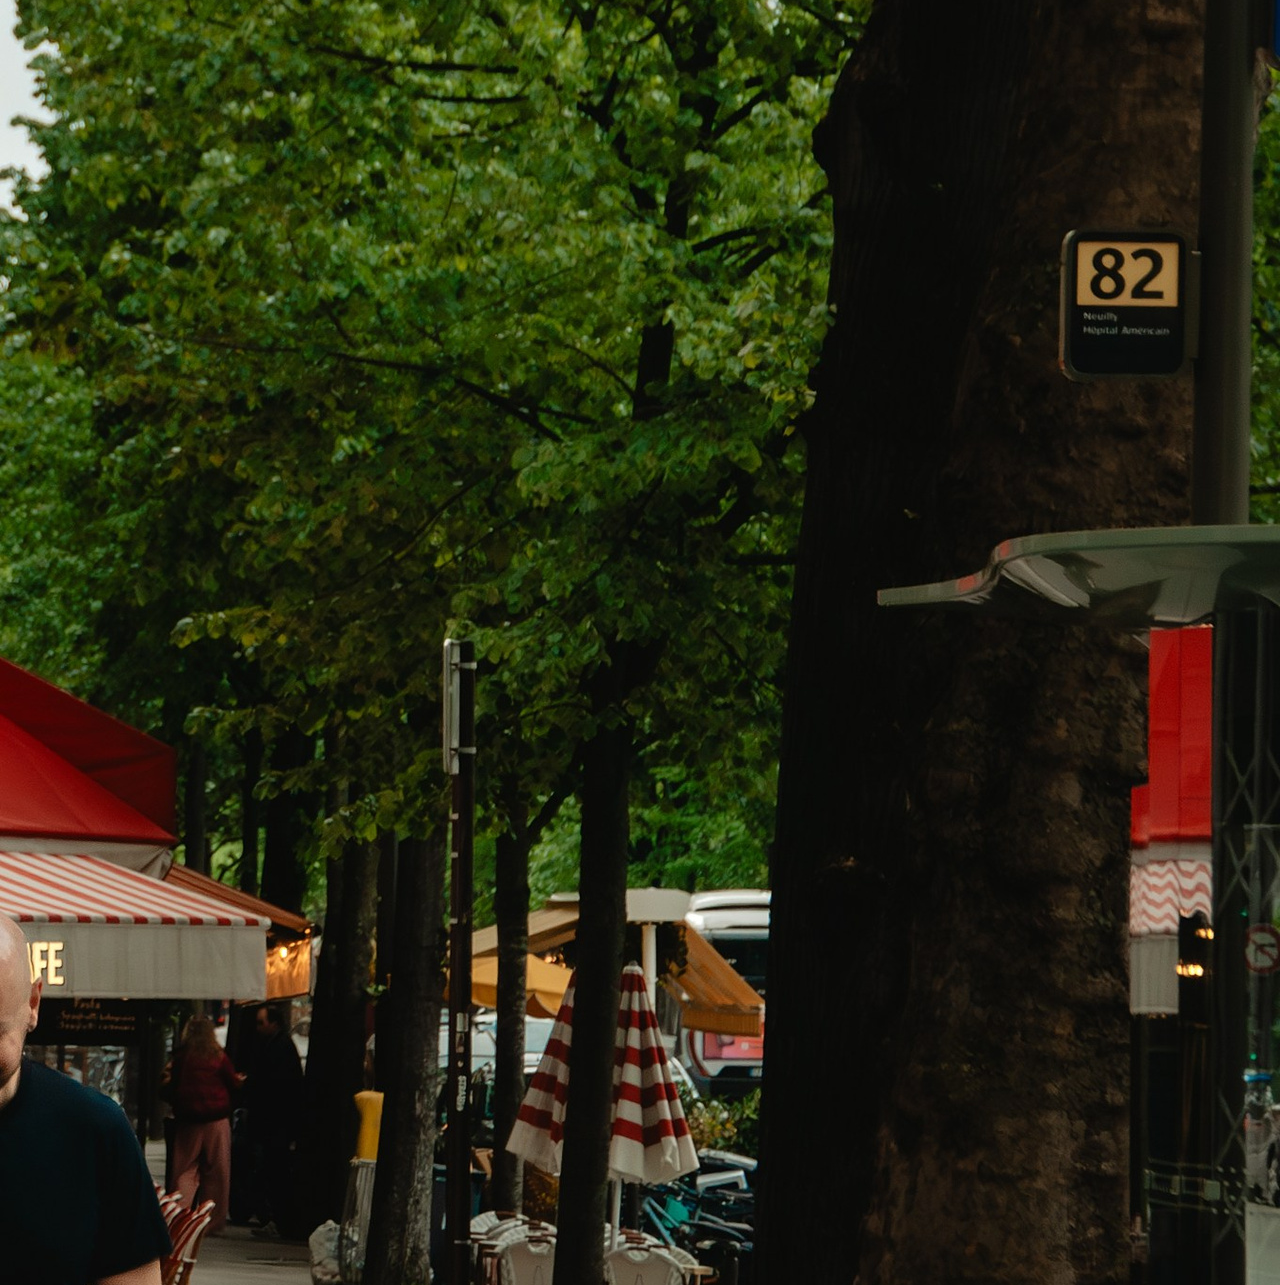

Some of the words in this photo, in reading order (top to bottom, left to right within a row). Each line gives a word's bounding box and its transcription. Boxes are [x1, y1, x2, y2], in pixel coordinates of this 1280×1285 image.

[1089, 247, 1164, 300] 82
[1083, 311, 1118, 322] Neuilly
[1083, 324, 1118, 336] Hôpital
[1121, 324, 1170, 336] Américain
